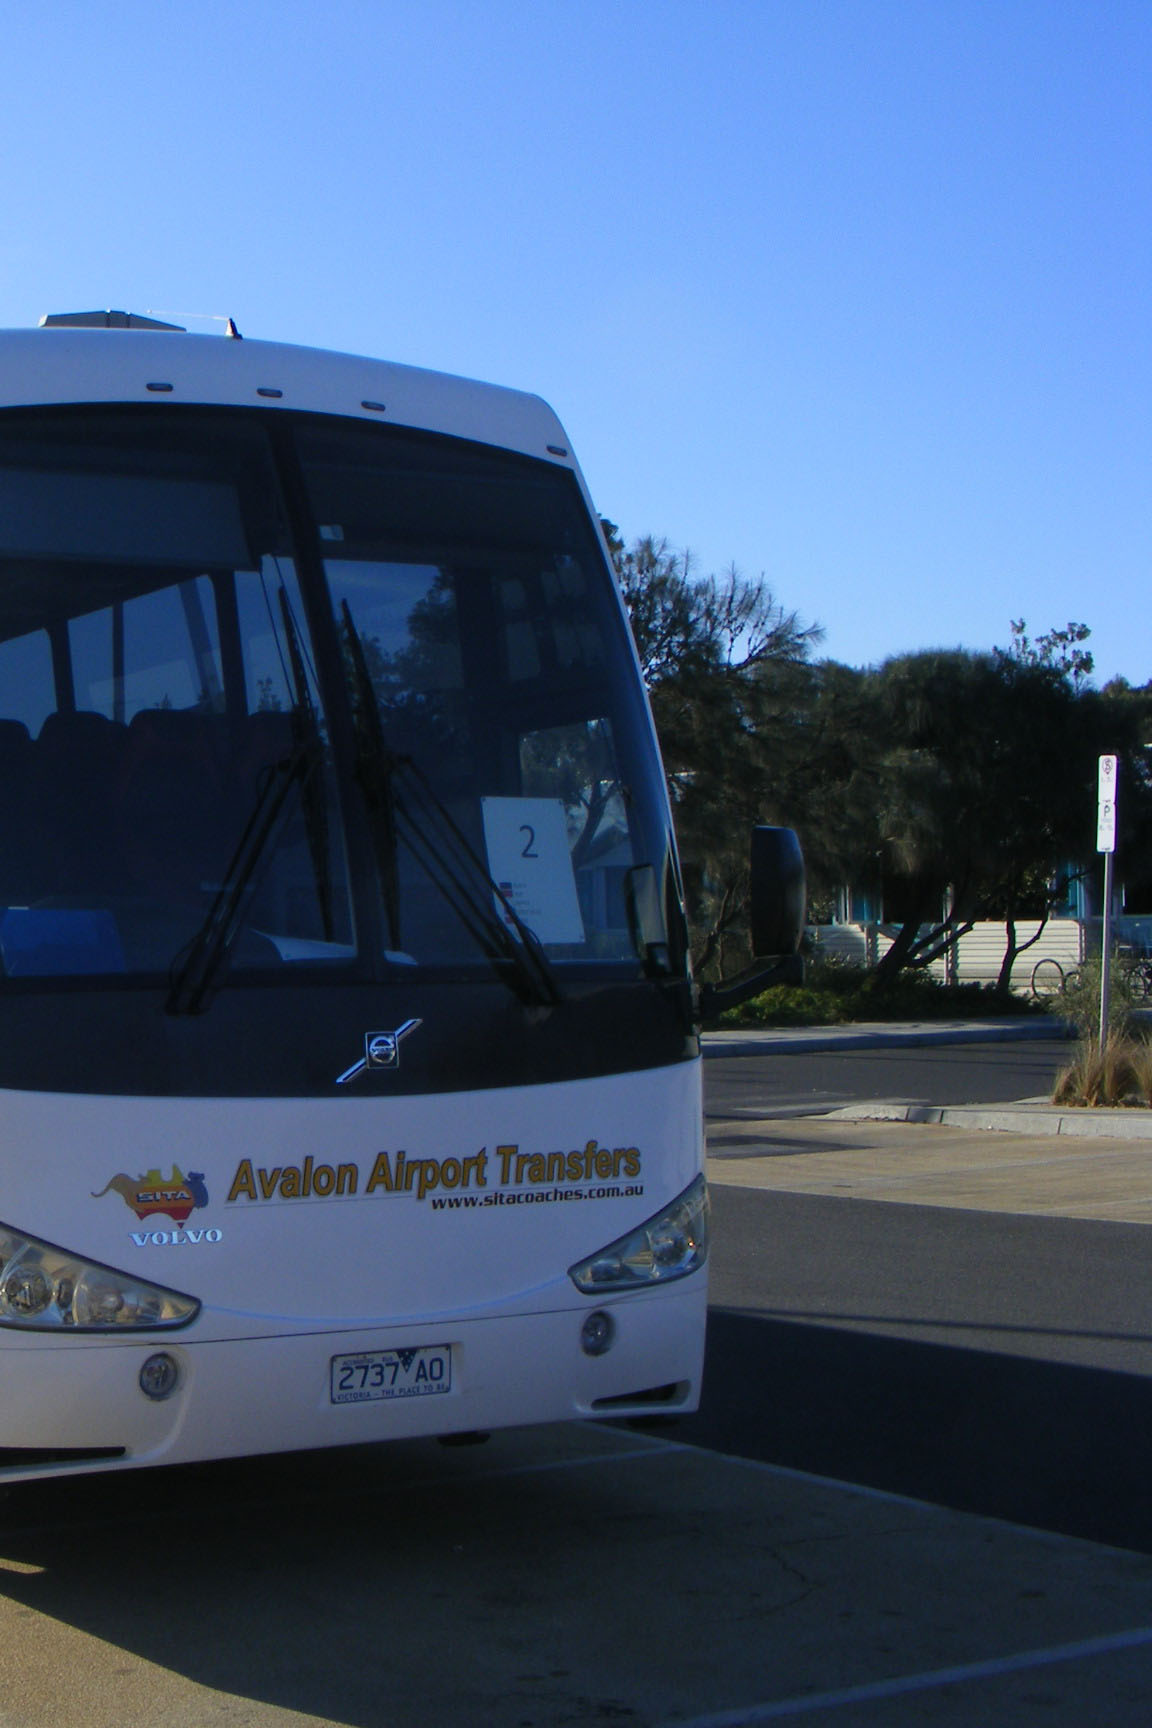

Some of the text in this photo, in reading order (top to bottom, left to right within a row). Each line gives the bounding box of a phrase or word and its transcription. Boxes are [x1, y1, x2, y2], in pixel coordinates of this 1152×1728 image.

[519, 824, 539, 858] 2
[227, 1140, 642, 1202] Avalon Airport Transfers
[431, 1185, 645, 1210] www.sitacoaches.com.au
[130, 1229, 223, 1247] VOLVO
[339, 1362, 400, 1391] 2737
[337, 1391, 371, 1401] VICTORIA
[382, 1388, 395, 1397] THE
[399, 1385, 420, 1395] PLACE
[424, 1383, 433, 1391] TO
